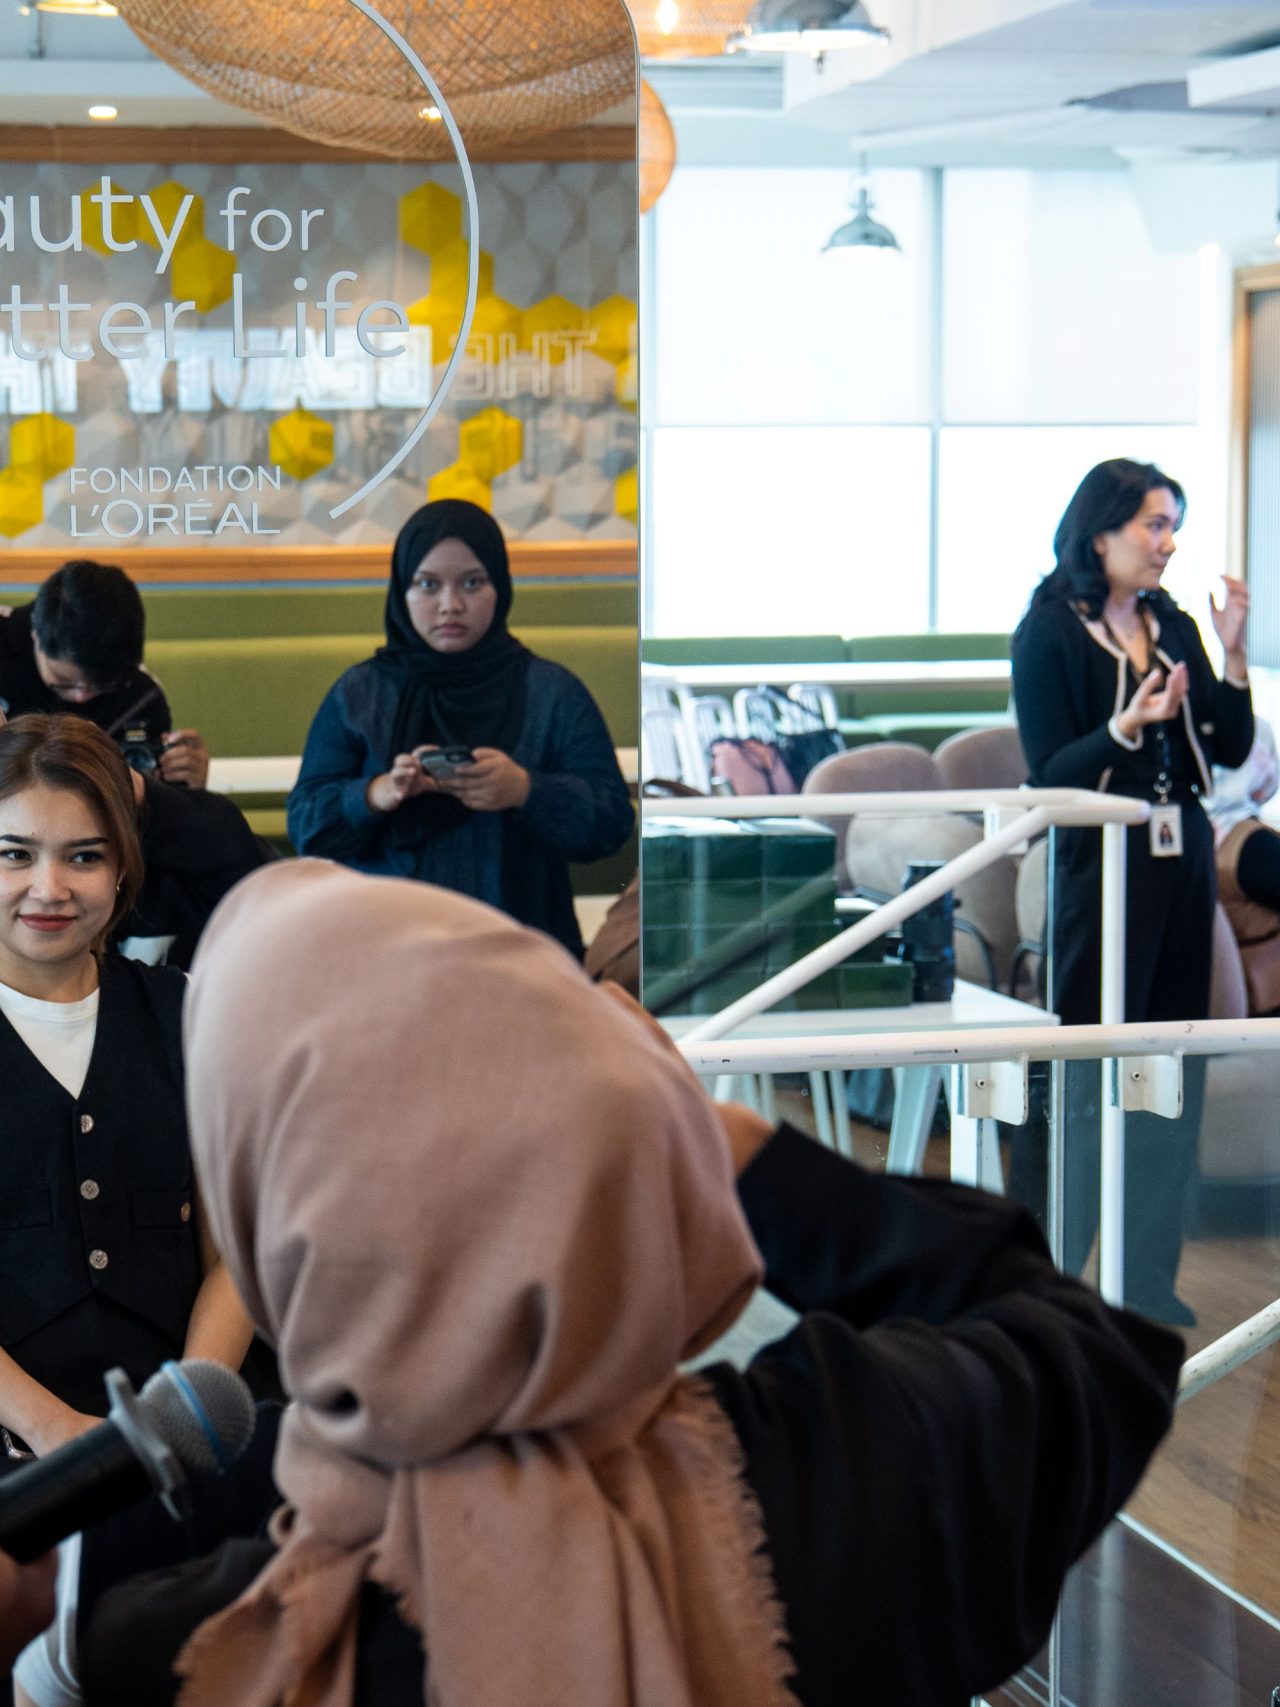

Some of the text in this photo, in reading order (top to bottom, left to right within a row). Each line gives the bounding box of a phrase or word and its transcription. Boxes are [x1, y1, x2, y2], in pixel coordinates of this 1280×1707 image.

[219, 187, 325, 252] for
[233, 270, 410, 359] Life
[69, 464, 283, 494] FONDATION
[70, 497, 281, 539] L'ORÉAL
